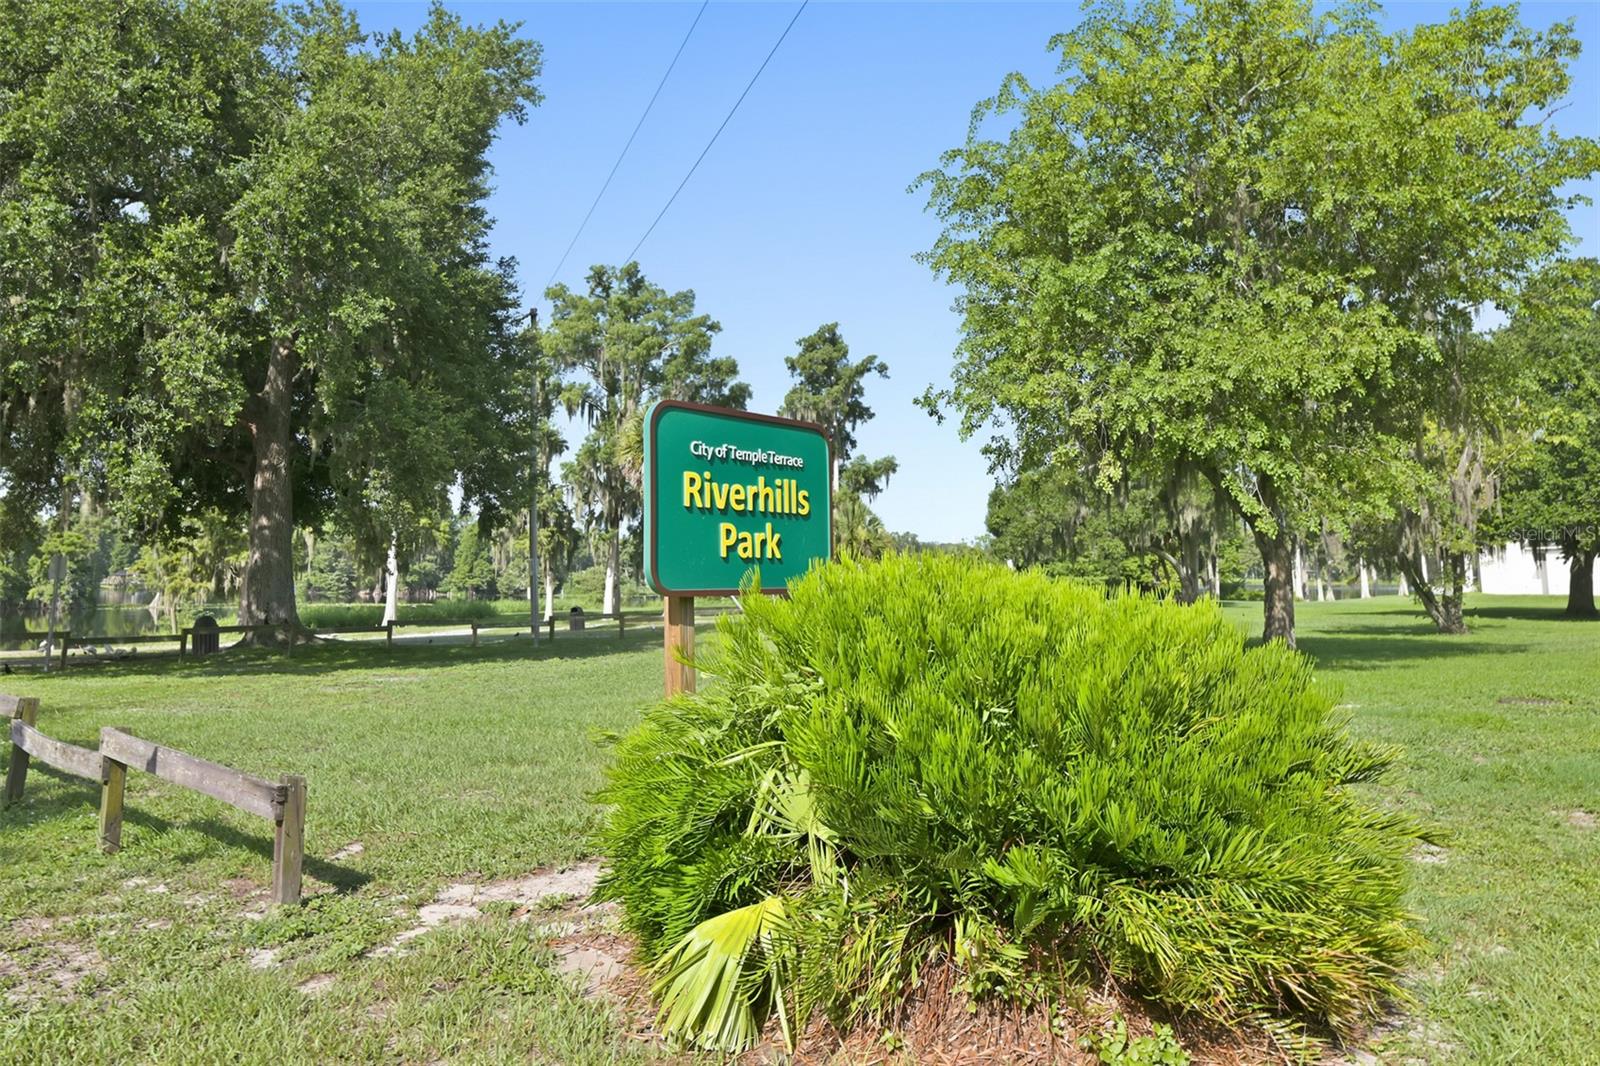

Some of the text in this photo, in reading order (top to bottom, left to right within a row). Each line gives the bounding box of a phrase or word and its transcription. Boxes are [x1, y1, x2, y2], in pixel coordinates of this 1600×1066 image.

[690, 441, 804, 468] City of Temple Terrace
[683, 471, 811, 516] Riverhills
[719, 522, 782, 560] Park
